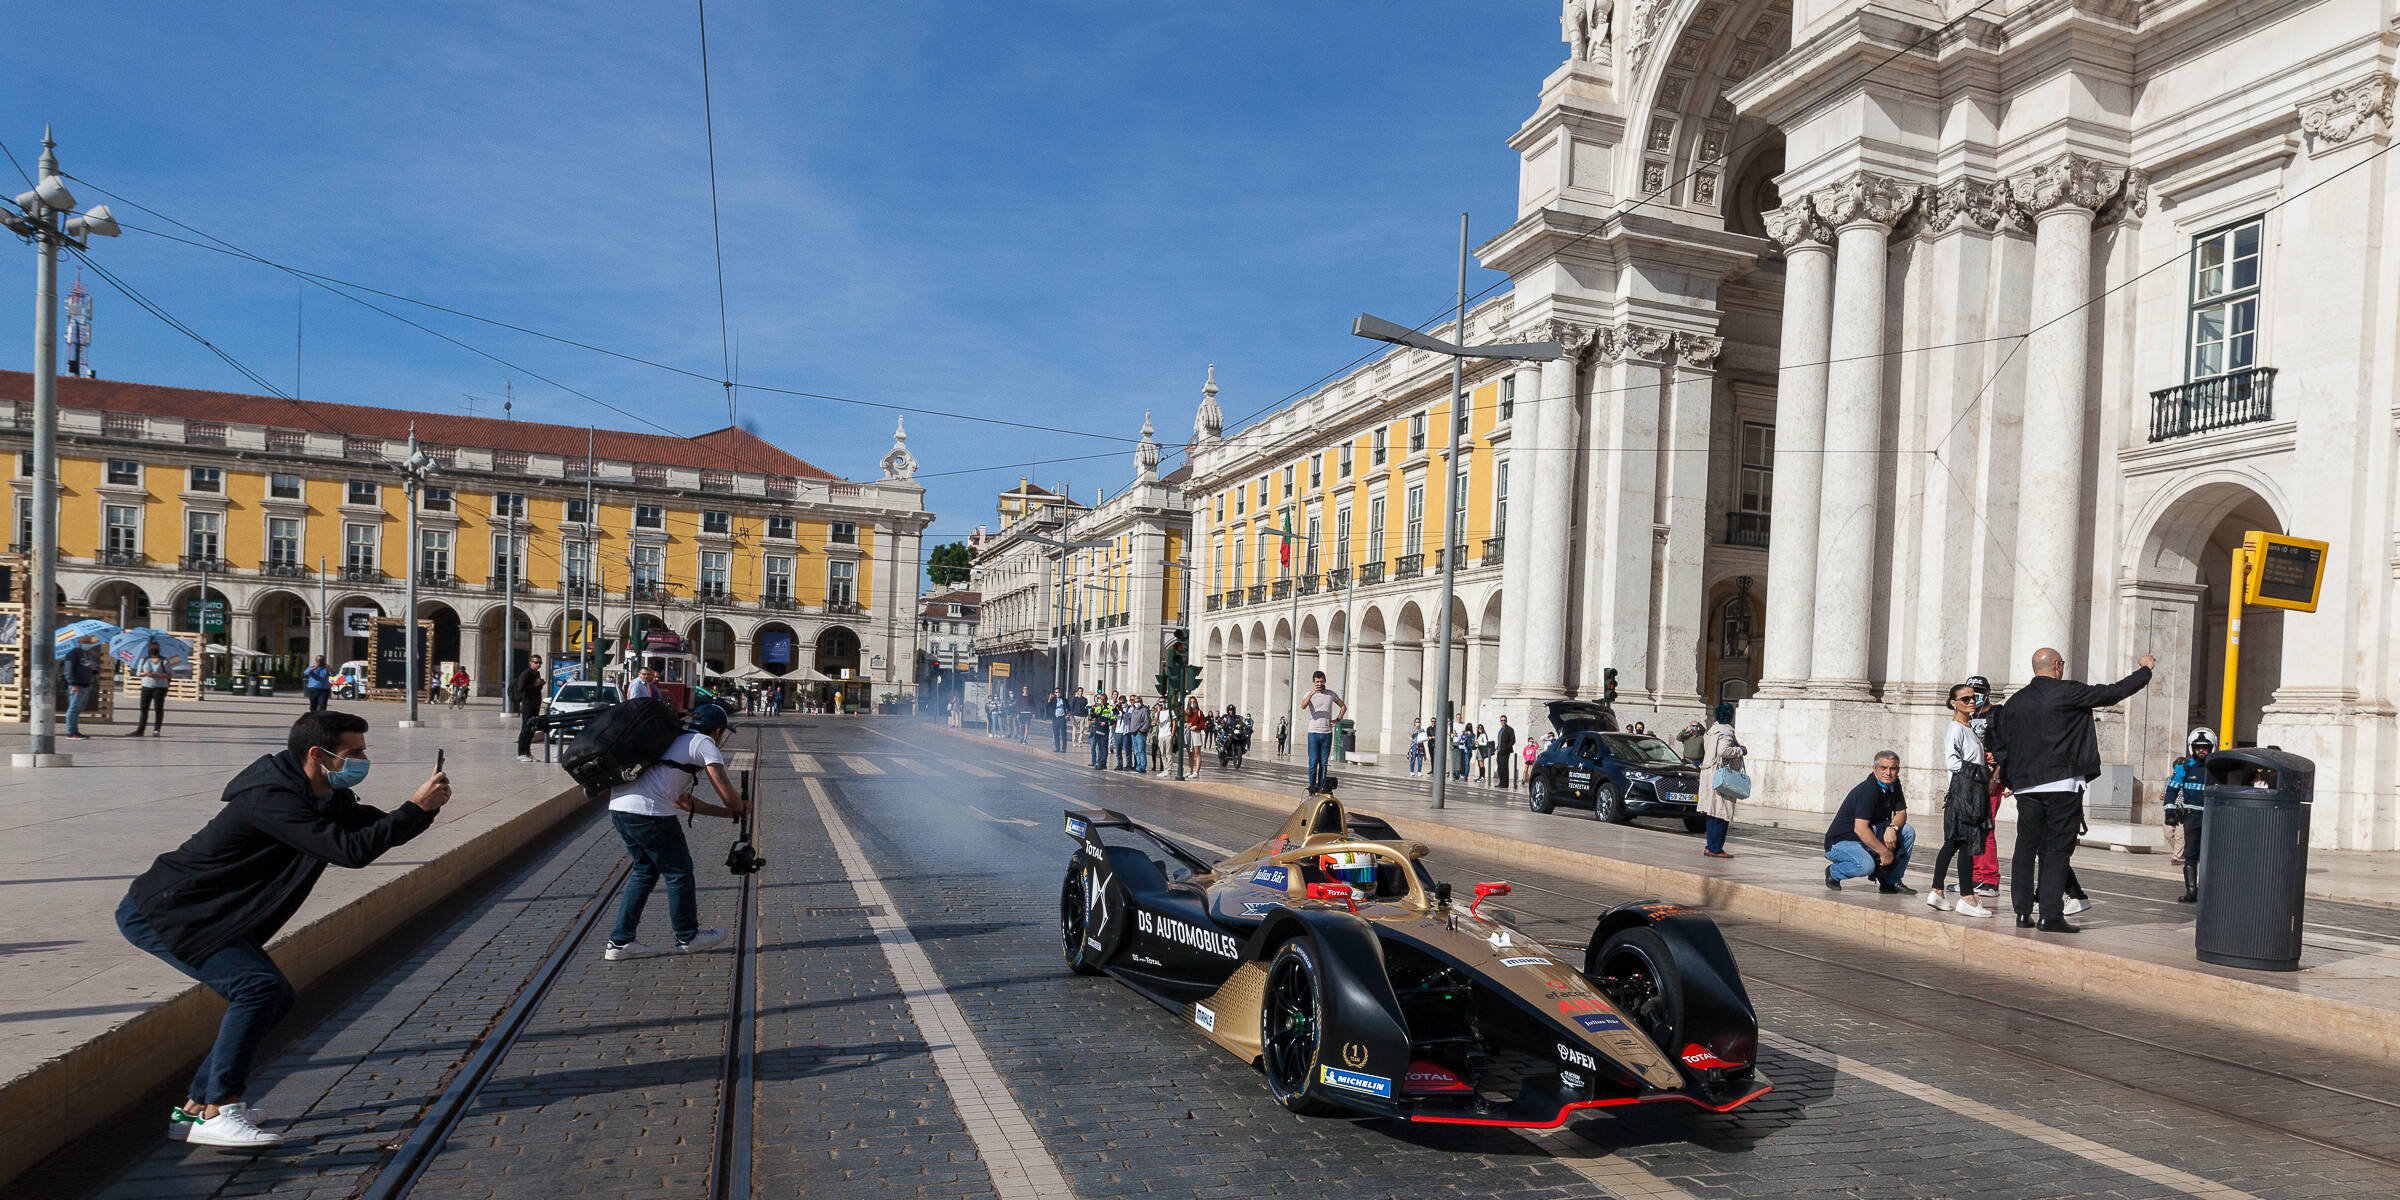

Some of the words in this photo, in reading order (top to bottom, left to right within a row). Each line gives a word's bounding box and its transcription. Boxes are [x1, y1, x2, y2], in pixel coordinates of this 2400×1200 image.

[1086, 840, 1103, 861] TOTAL
[1271, 871, 1286, 884] Bär
[1138, 909, 1153, 934] DS
[1156, 915, 1239, 960] AUTOMOBILES
[1196, 1008, 1213, 1027] MAHLE
[1352, 1044, 1358, 1057] 1
[1682, 1052, 1718, 1064] TOTAL
[1337, 1075, 1385, 1091] MICHELIN
[1404, 1072, 1453, 1081] TOTAL
